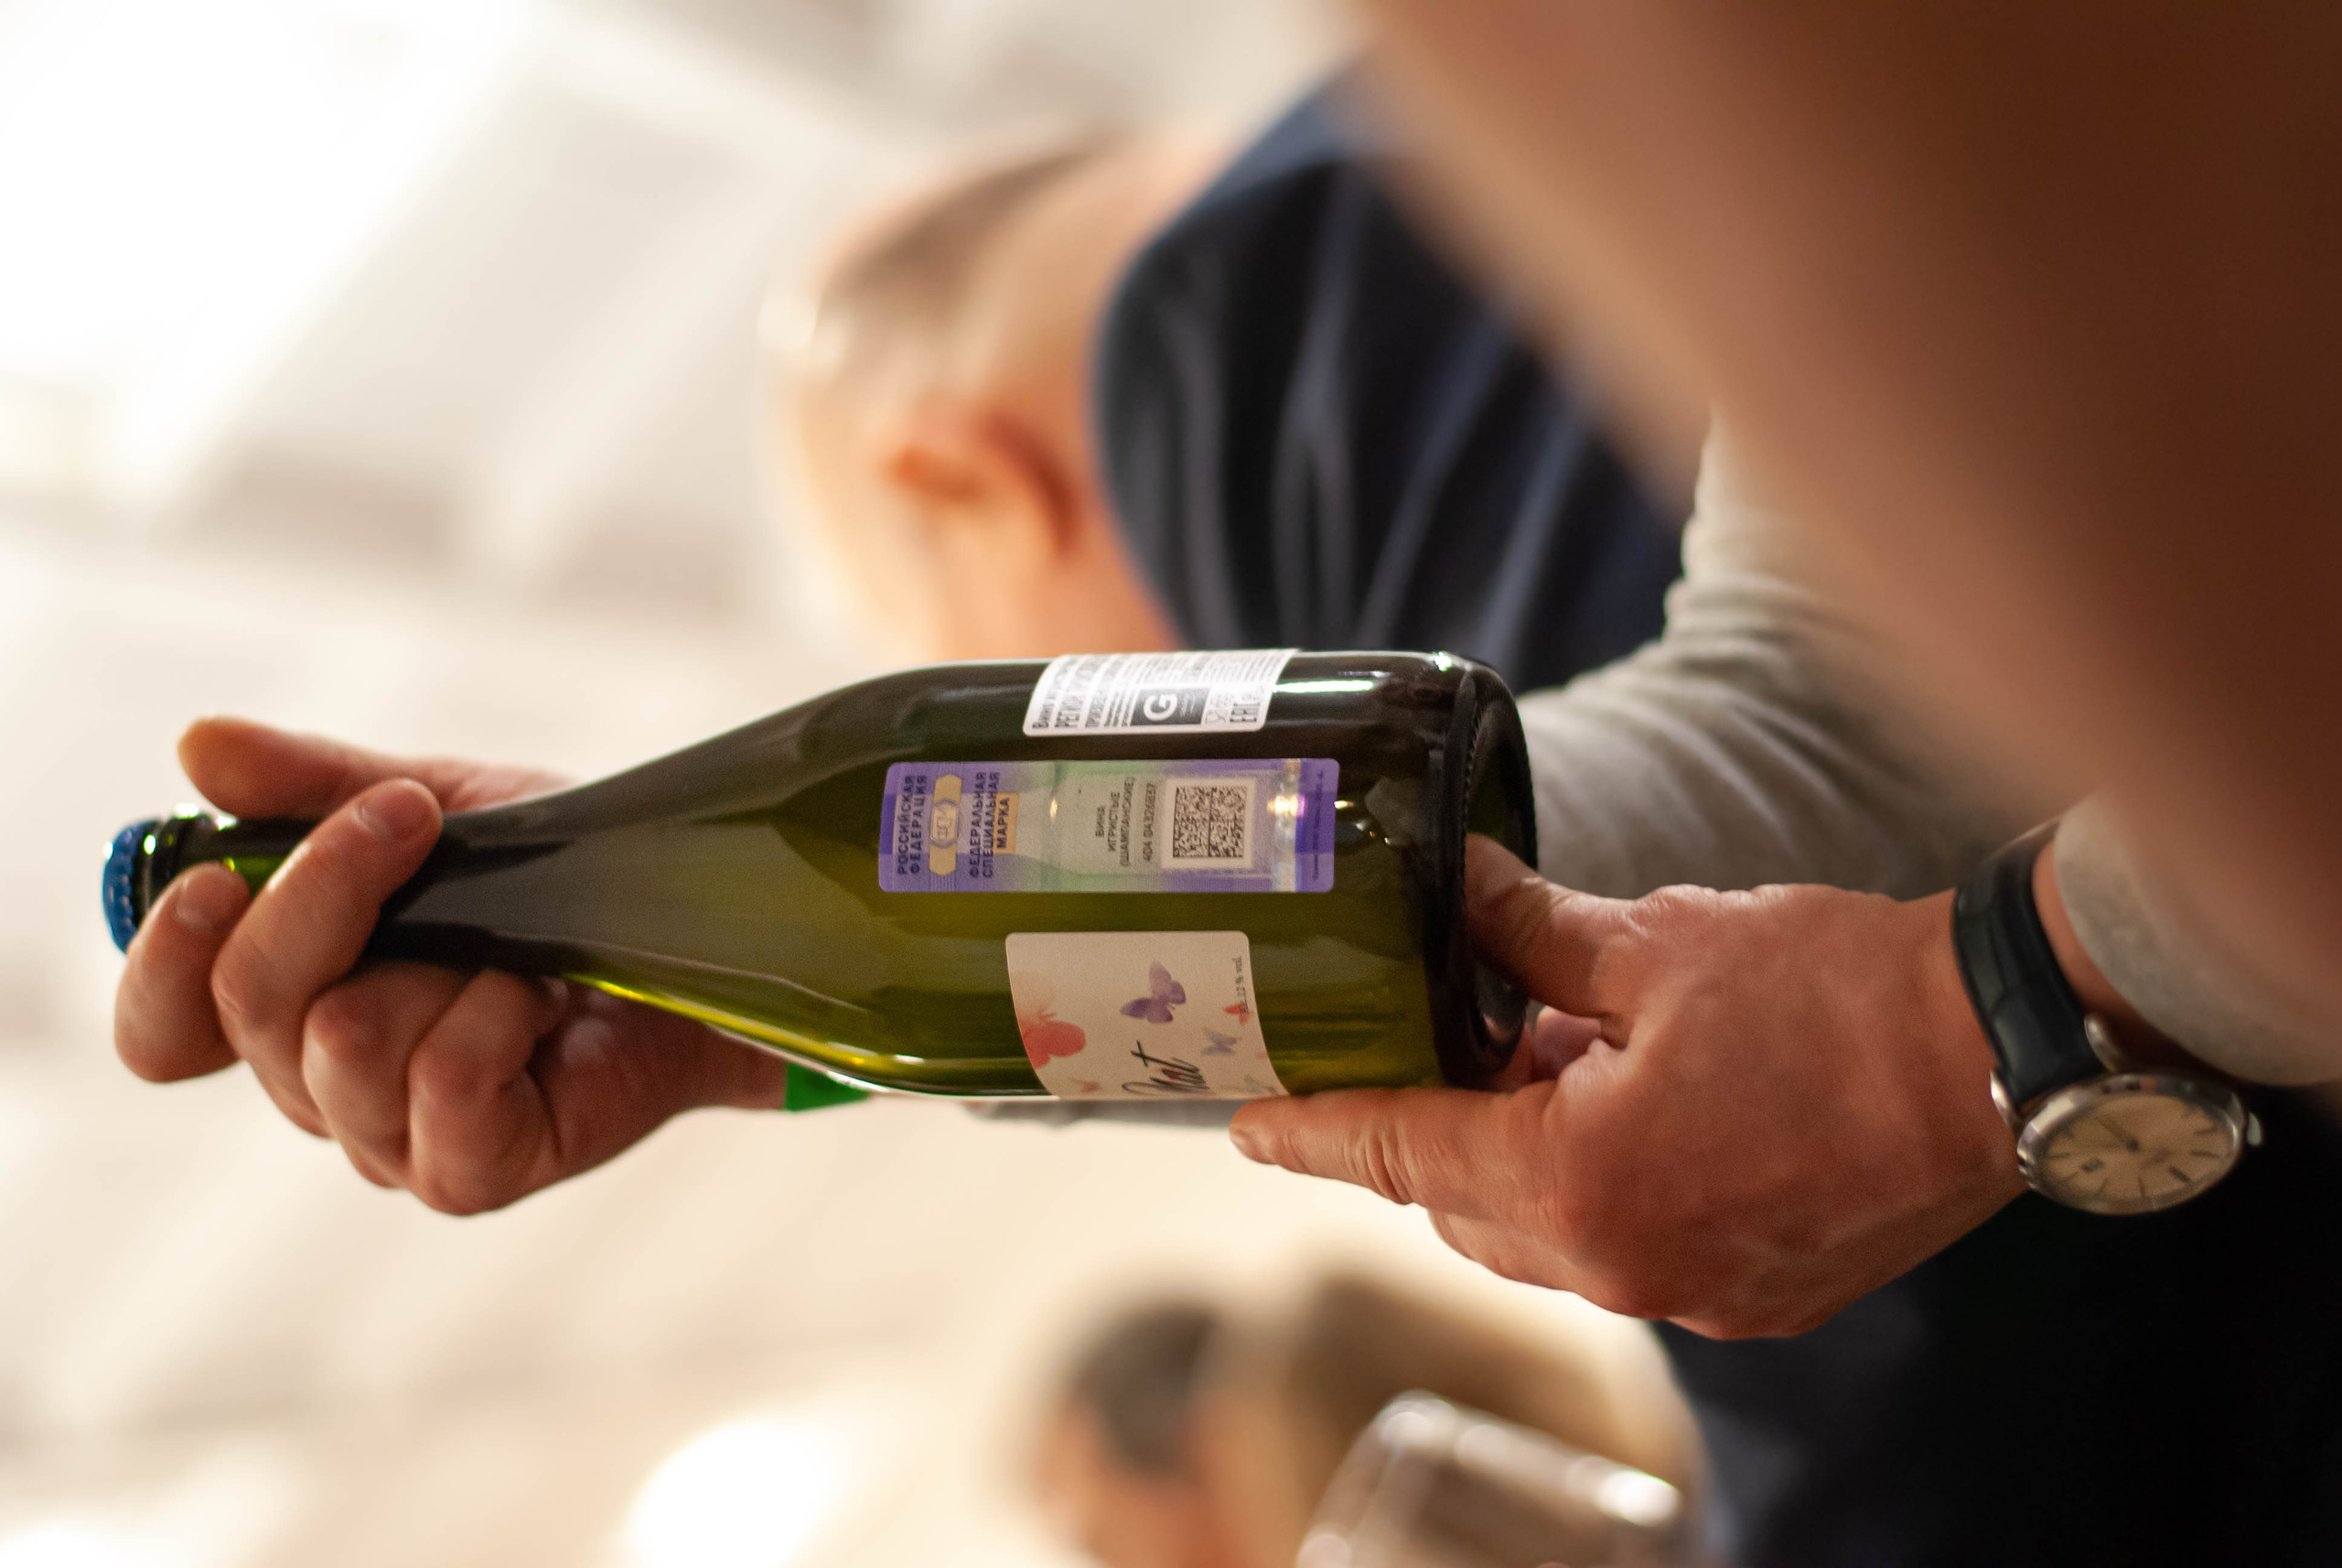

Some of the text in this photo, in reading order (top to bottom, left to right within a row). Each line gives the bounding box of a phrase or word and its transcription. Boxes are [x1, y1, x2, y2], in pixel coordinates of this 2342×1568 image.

[1143, 693, 1177, 721] G
[897, 776, 915, 875] РОССИЙСКАЯ
[909, 775, 928, 875] ФЕДЕРАЦИЯ
[969, 772, 986, 878] ФЕДЕРАЛЬНАЯ
[982, 772, 1000, 878] СПЕЦИАЛЬНАЯ
[996, 798, 1010, 849] МАРКА
[1095, 806, 1106, 838] ВИНА
[1107, 791, 1120, 853] ИГРИСТЫЕ
[1120, 777, 1136, 867] (ШАМПАНСКИЕ)
